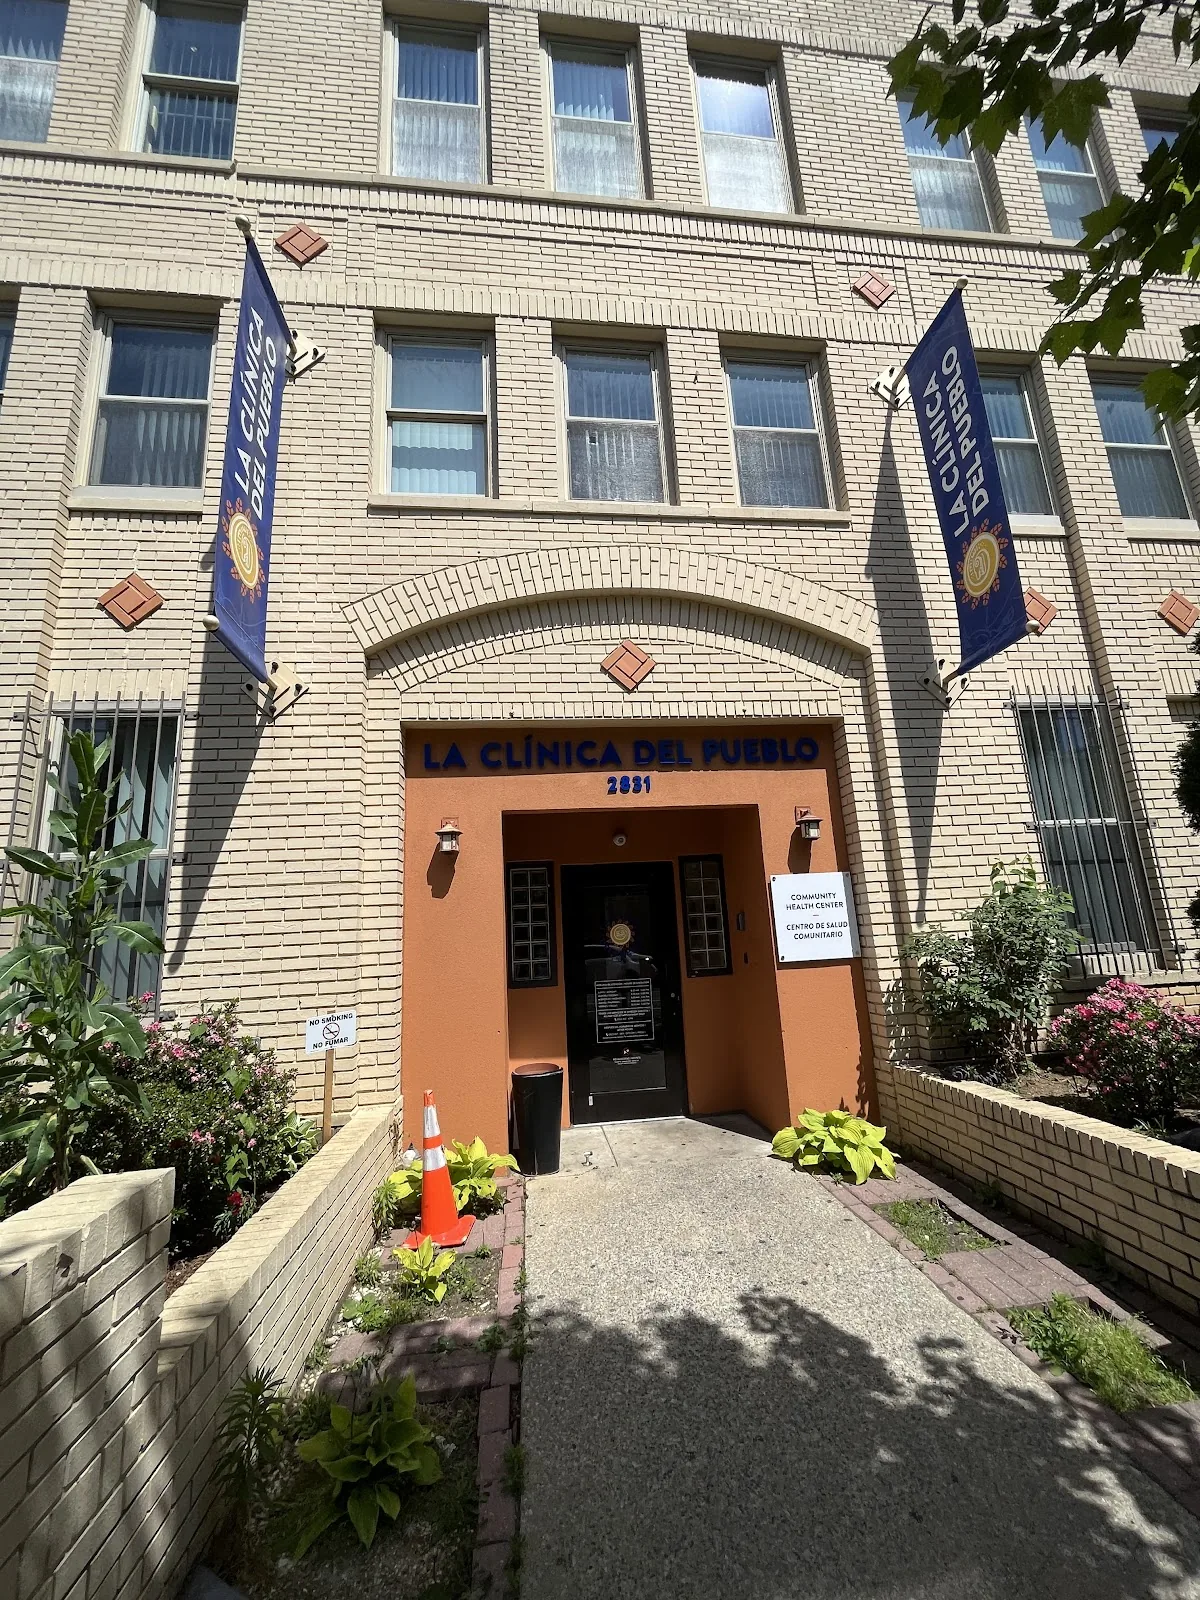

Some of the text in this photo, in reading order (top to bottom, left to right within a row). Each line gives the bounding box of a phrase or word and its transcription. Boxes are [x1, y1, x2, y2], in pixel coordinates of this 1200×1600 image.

[234, 306, 264, 496] LA CLÍNICA
[250, 336, 277, 521] DEL PUEBLO
[942, 345, 990, 518] DEL PUEBLO
[922, 369, 970, 538] LA CLÍNICA
[423, 734, 821, 770] LA CLÍNICA DEL PUEBLO
[606, 775, 651, 796] 2831
[790, 892, 837, 901] COMMUNITY
[786, 901, 844, 911] HEALTH CENTER
[786, 923, 814, 931] CENTRO
[826, 921, 848, 929] SALUD
[793, 930, 843, 940] COMUNITARIO
[309, 1012, 353, 1027] NO SMOKING
[312, 1036, 349, 1050] NO FUMAR
